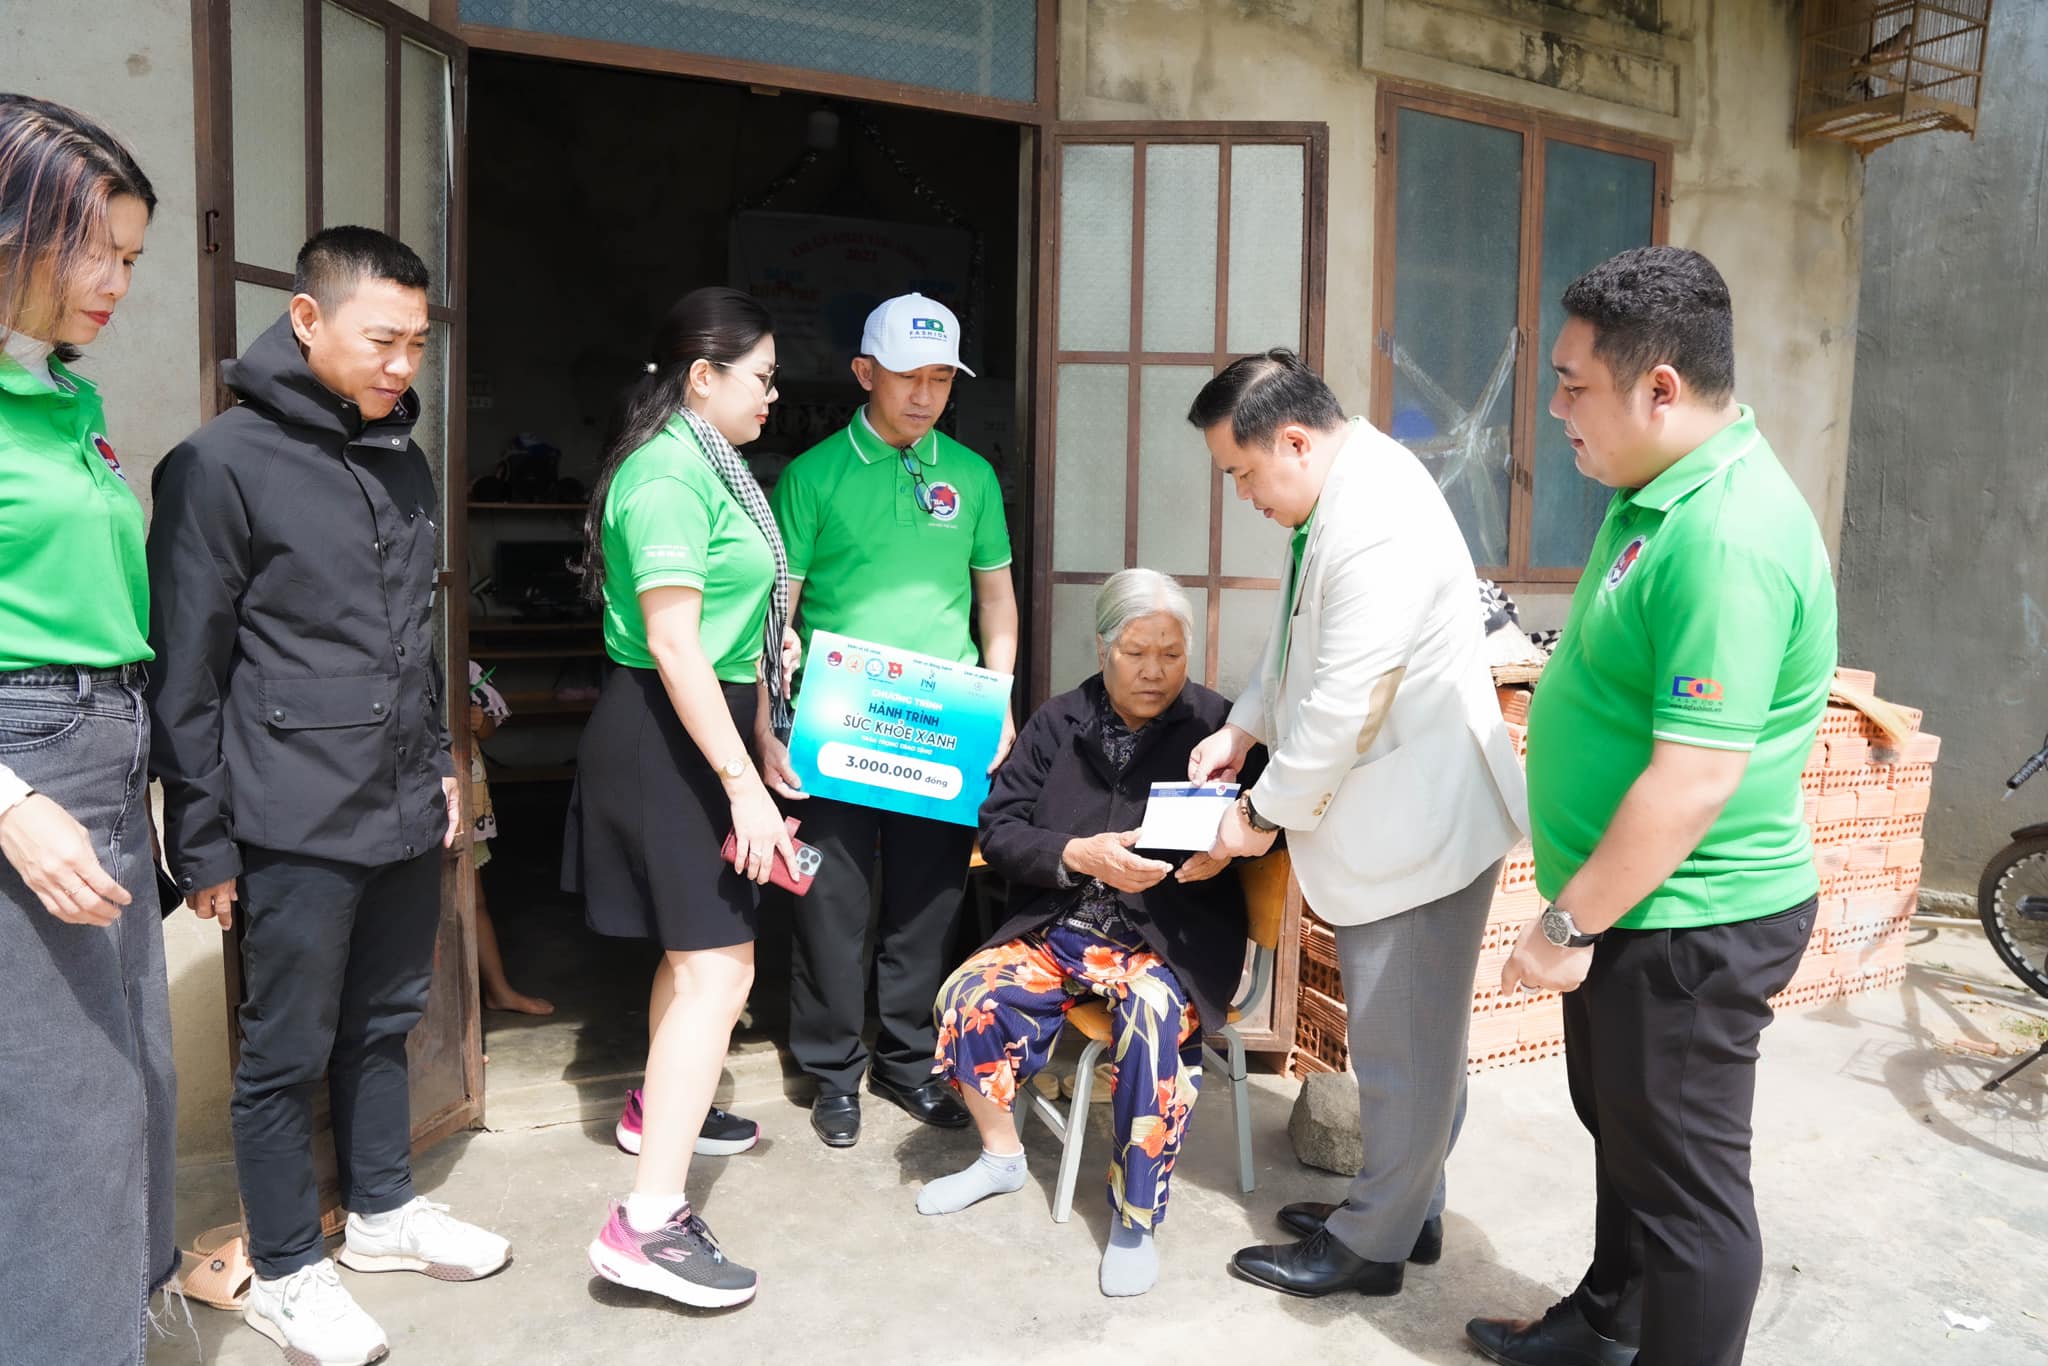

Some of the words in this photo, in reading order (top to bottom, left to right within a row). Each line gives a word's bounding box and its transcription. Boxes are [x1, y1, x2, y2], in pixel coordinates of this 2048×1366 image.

[868, 701, 902, 719] HÀNH
[906, 709, 939, 727] TRÌNH
[843, 712, 871, 731] SỨC
[875, 720, 913, 739] KHỎE
[916, 730, 956, 749] XANH
[845, 755, 923, 781] 3.000.000
